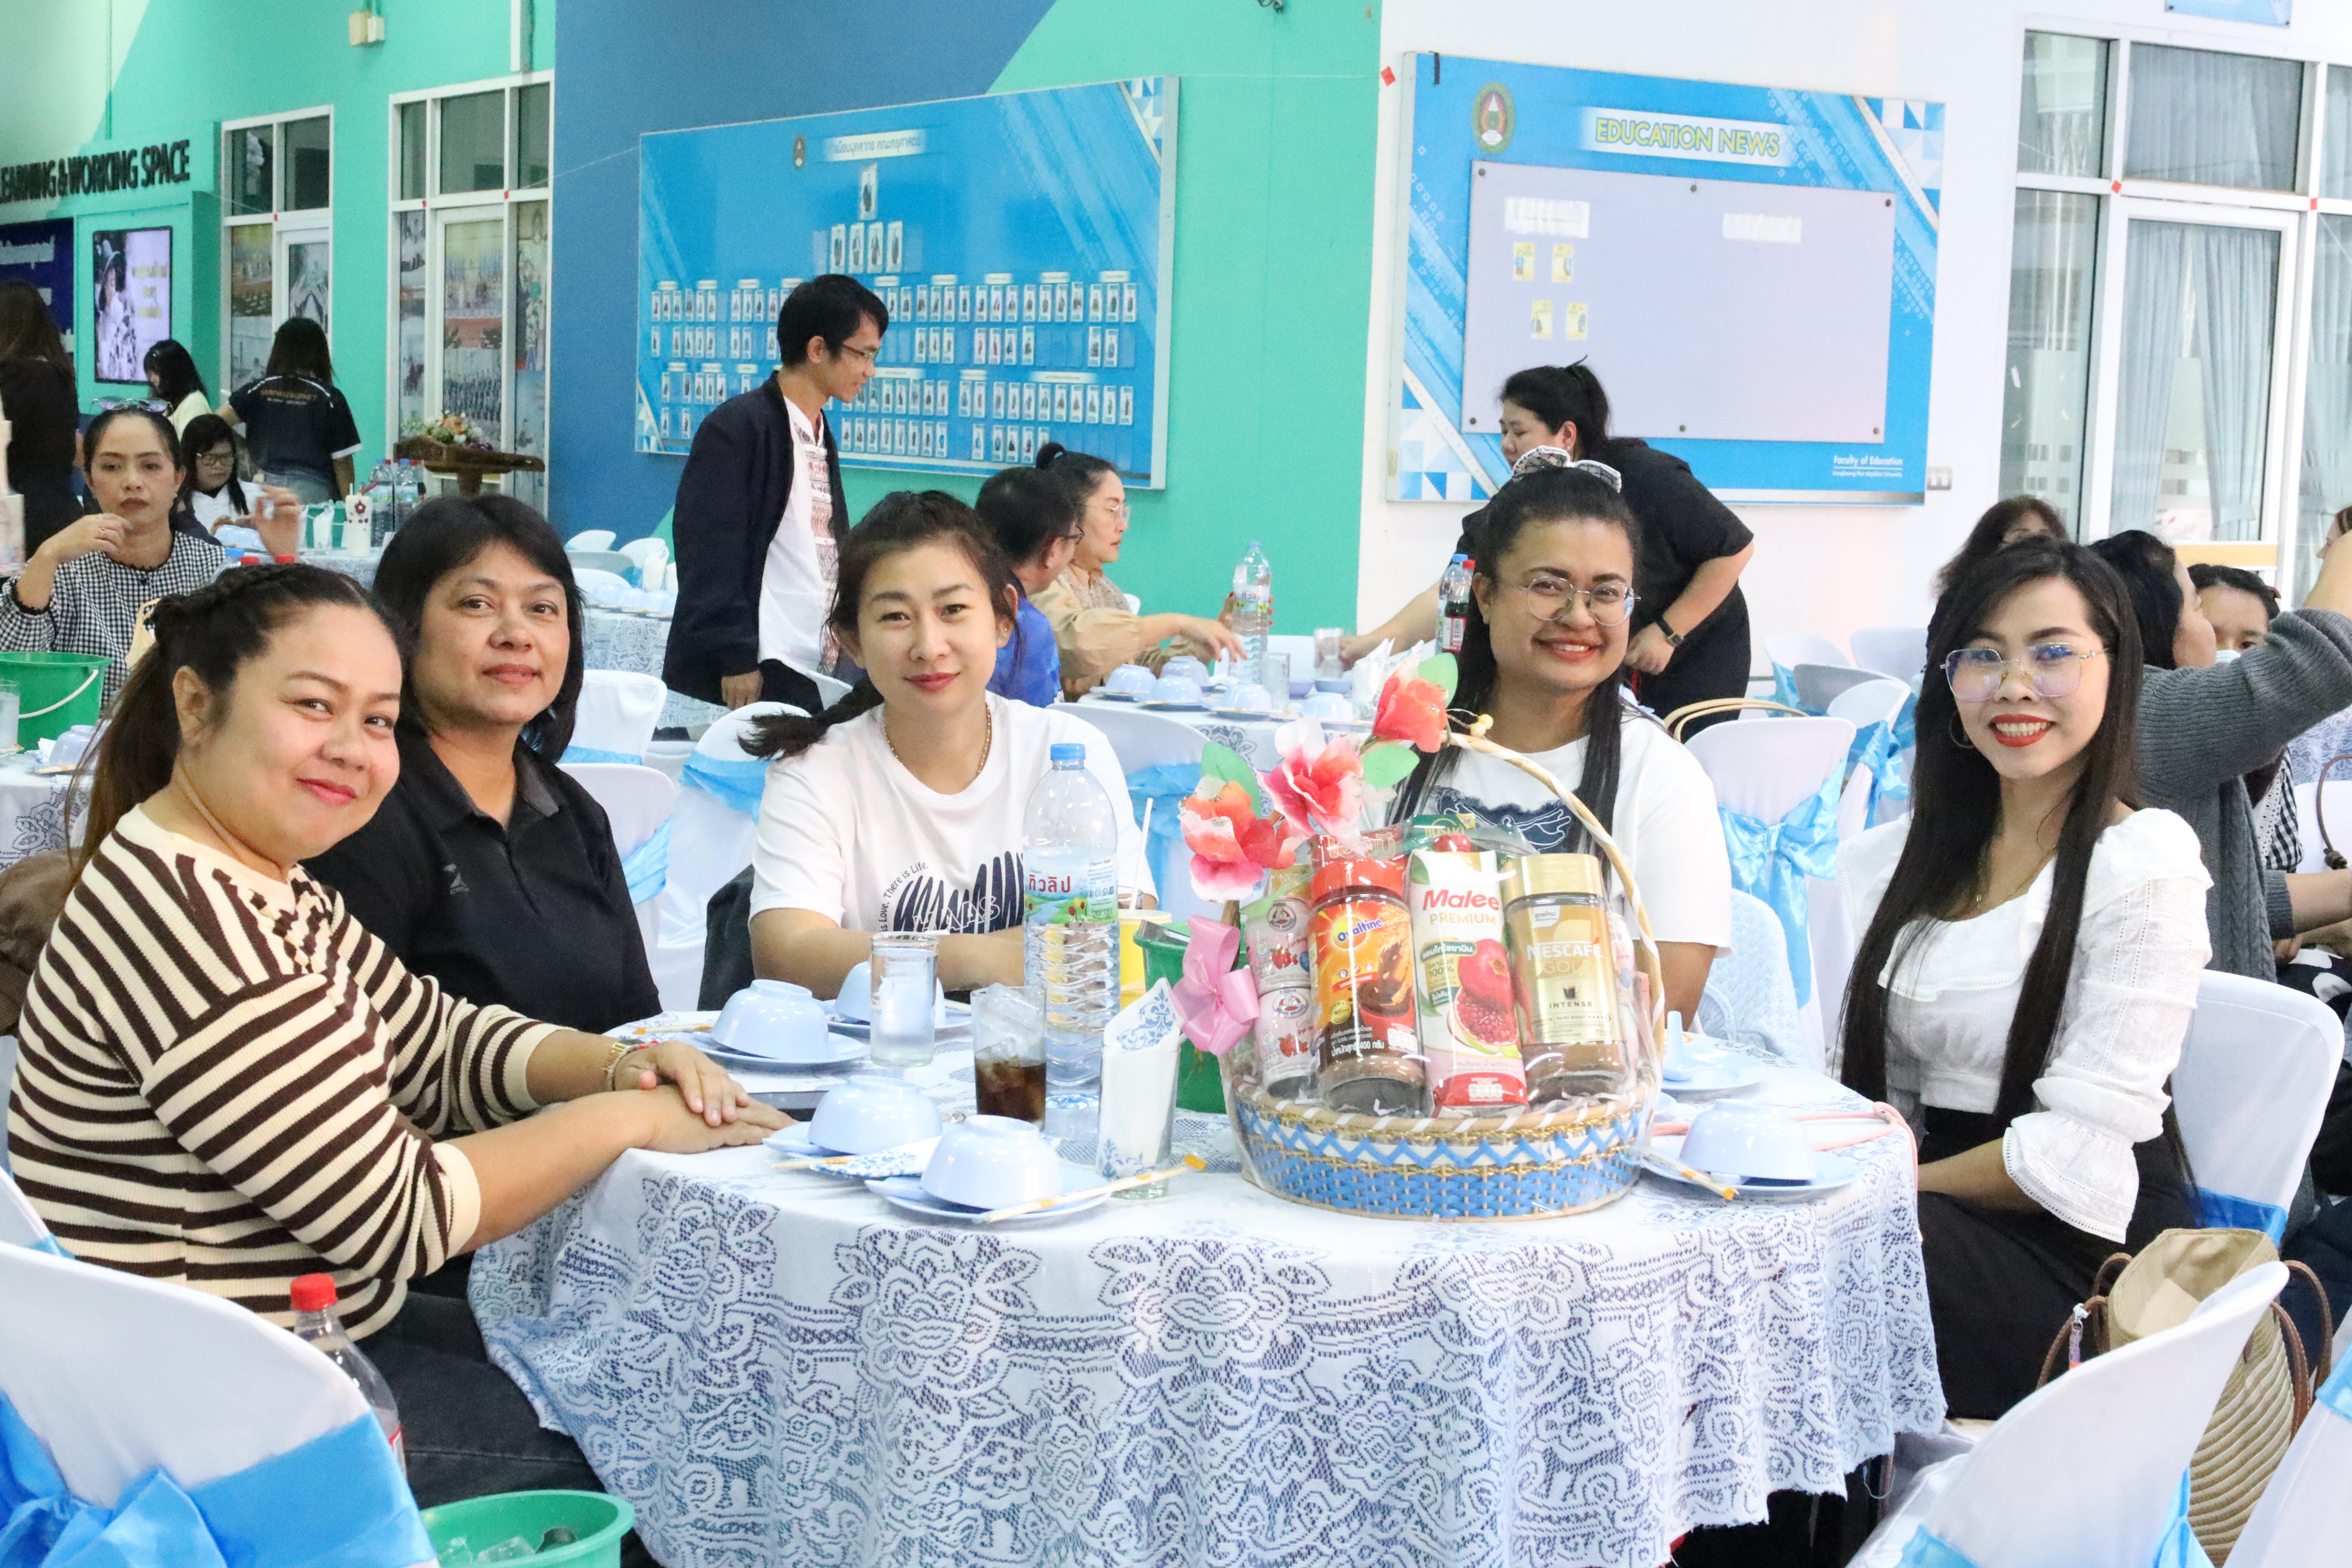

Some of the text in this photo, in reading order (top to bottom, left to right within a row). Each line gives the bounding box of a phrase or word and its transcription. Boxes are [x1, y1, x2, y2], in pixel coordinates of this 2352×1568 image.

[1596, 117, 1780, 157] EDUCATION NEWS
[68, 149, 138, 195] WORKING
[141, 139, 190, 188] SPACE
[1833, 455, 1903, 467] Faculty of Education
[900, 870, 910, 879] is
[910, 862, 928, 873] Life.
[883, 877, 903, 898] There
[1029, 874, 1070, 893] ทิวลิป
[1423, 889, 1499, 911] Malee
[878, 902, 890, 922] Love.
[1430, 912, 1496, 925] PREMIUM
